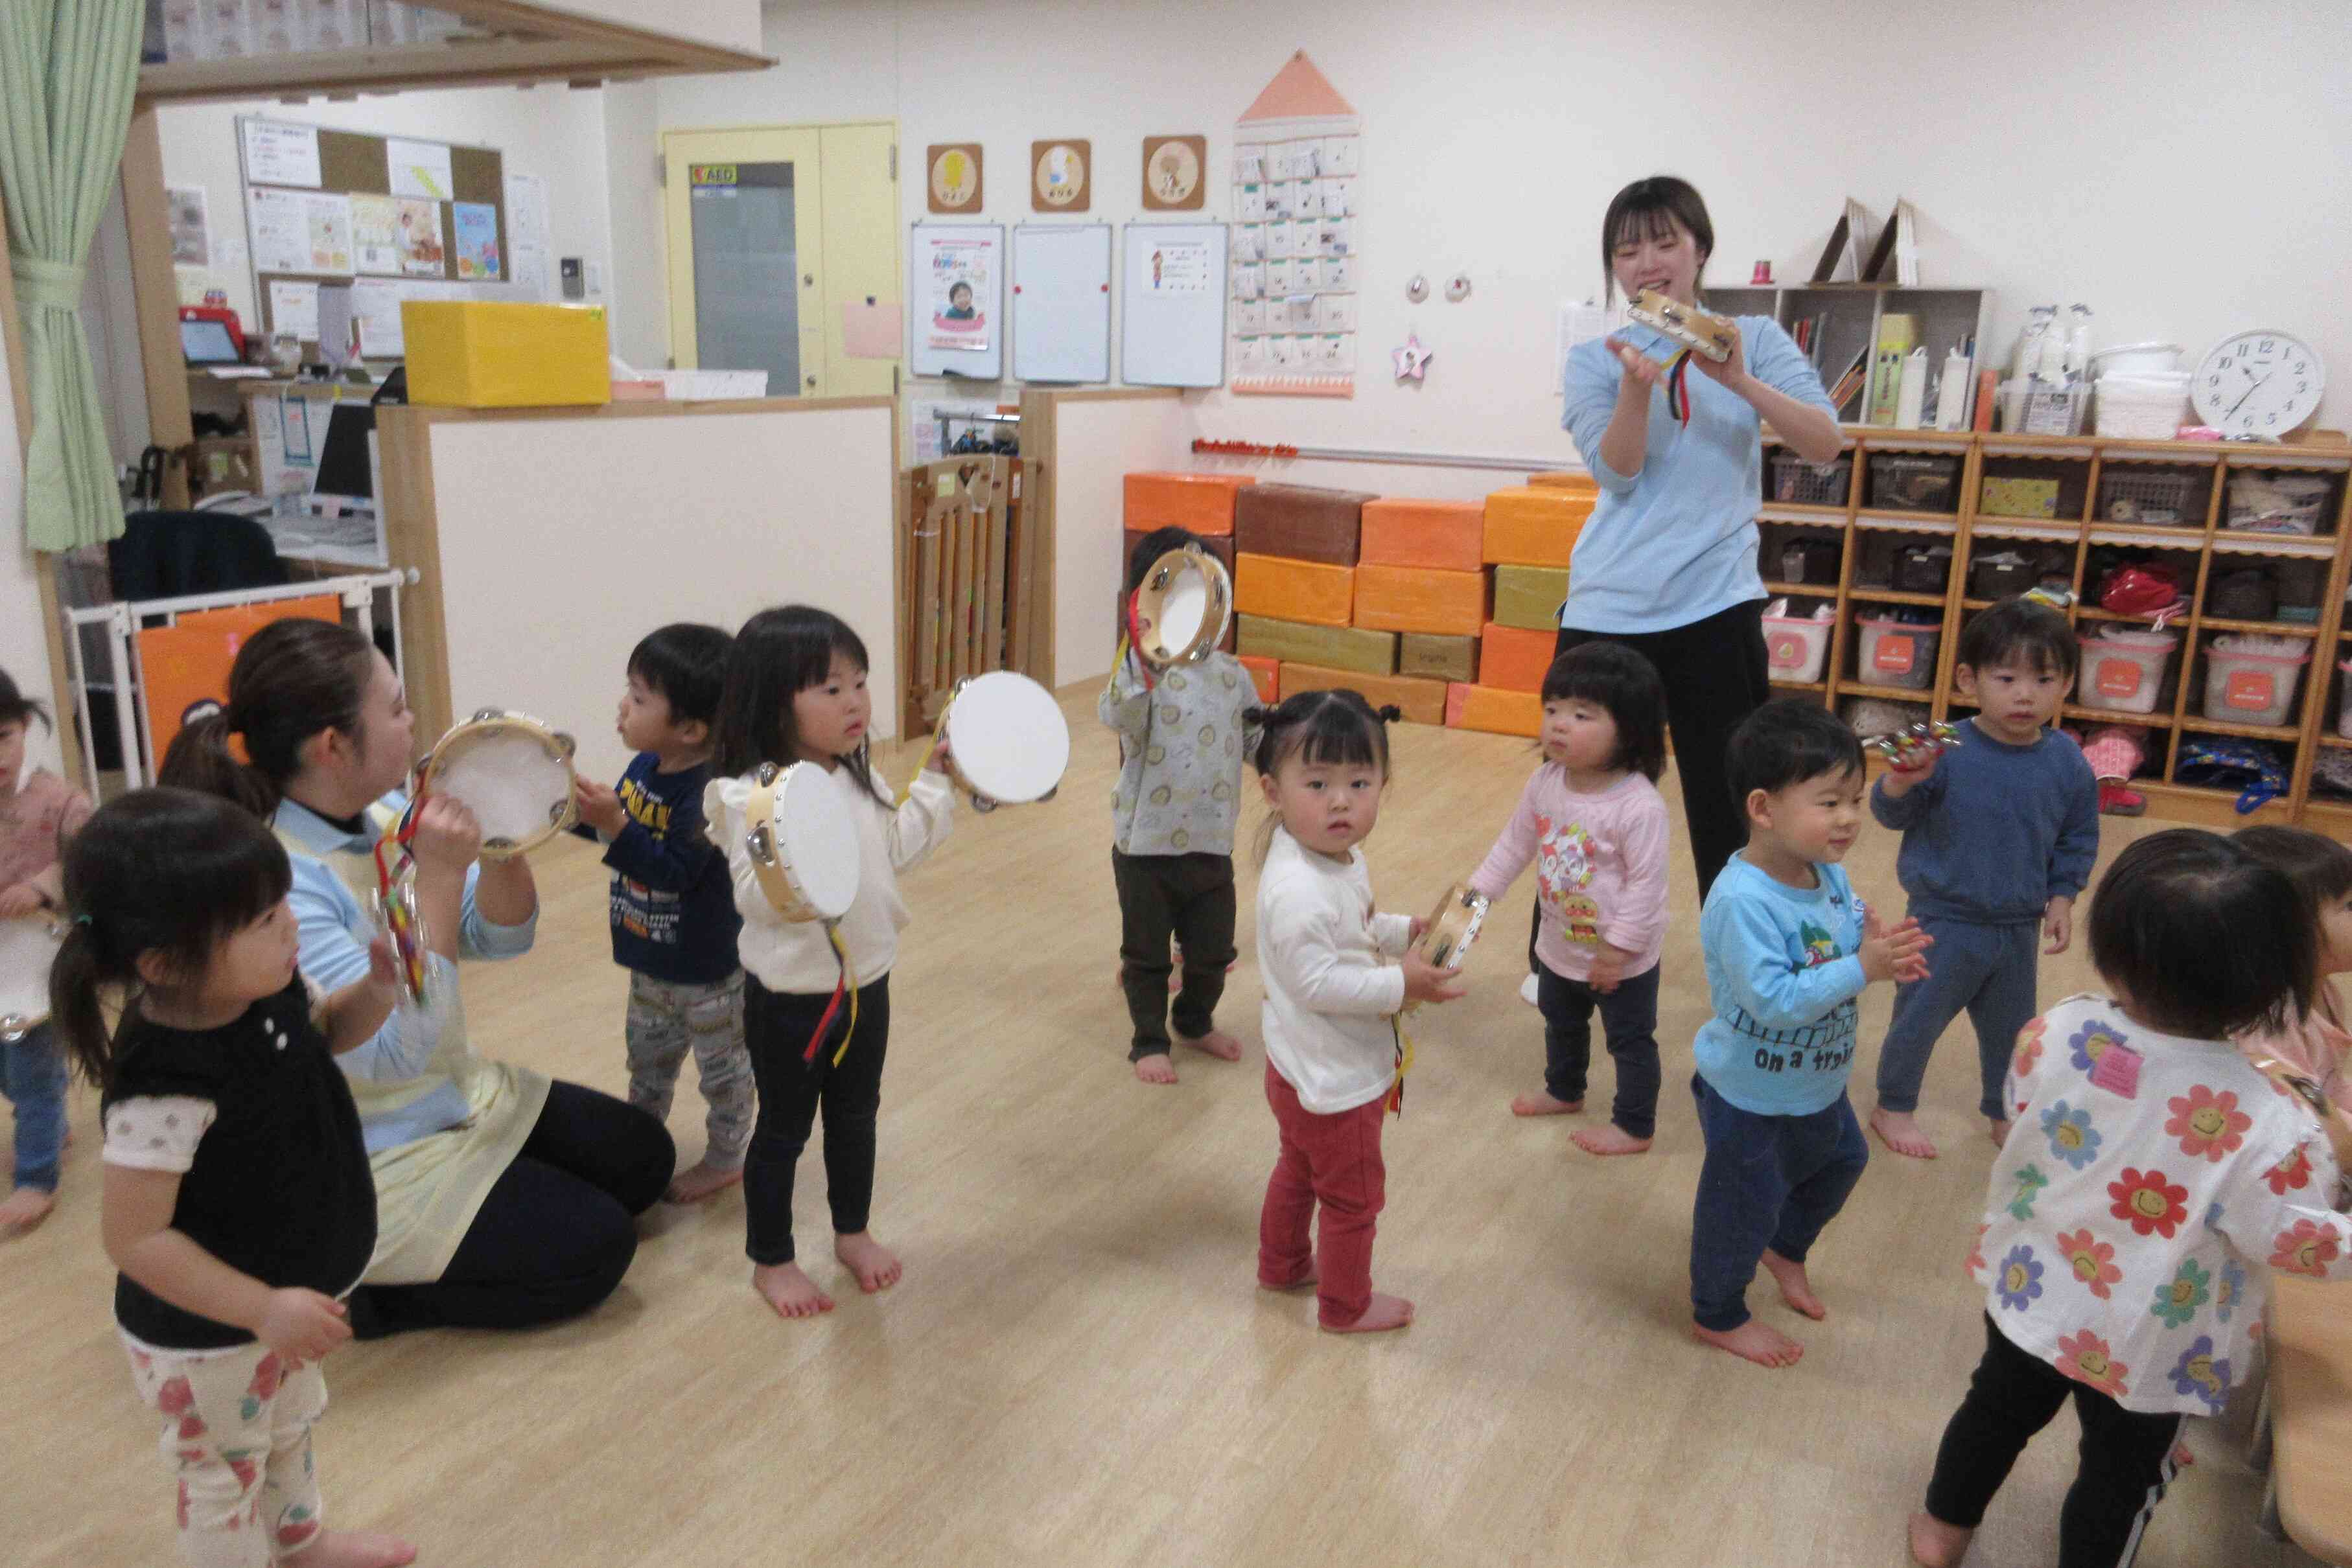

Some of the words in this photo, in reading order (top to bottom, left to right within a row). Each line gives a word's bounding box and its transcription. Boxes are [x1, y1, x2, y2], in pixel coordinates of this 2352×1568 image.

[705, 168, 732, 182] AED
[2237, 343, 2249, 356] 11
[2258, 340, 2274, 352] 12
[2281, 346, 2292, 360] 1
[2218, 356, 2232, 369] 10
[2294, 362, 2305, 375] 2
[2209, 374, 2219, 387] 9
[2296, 381, 2307, 393] 3
[2209, 394, 2220, 406] 8
[2283, 400, 2294, 411] 4
[2242, 415, 2253, 427] 6
[2265, 413, 2277, 424] 5
[1789, 1050, 1803, 1068] a
